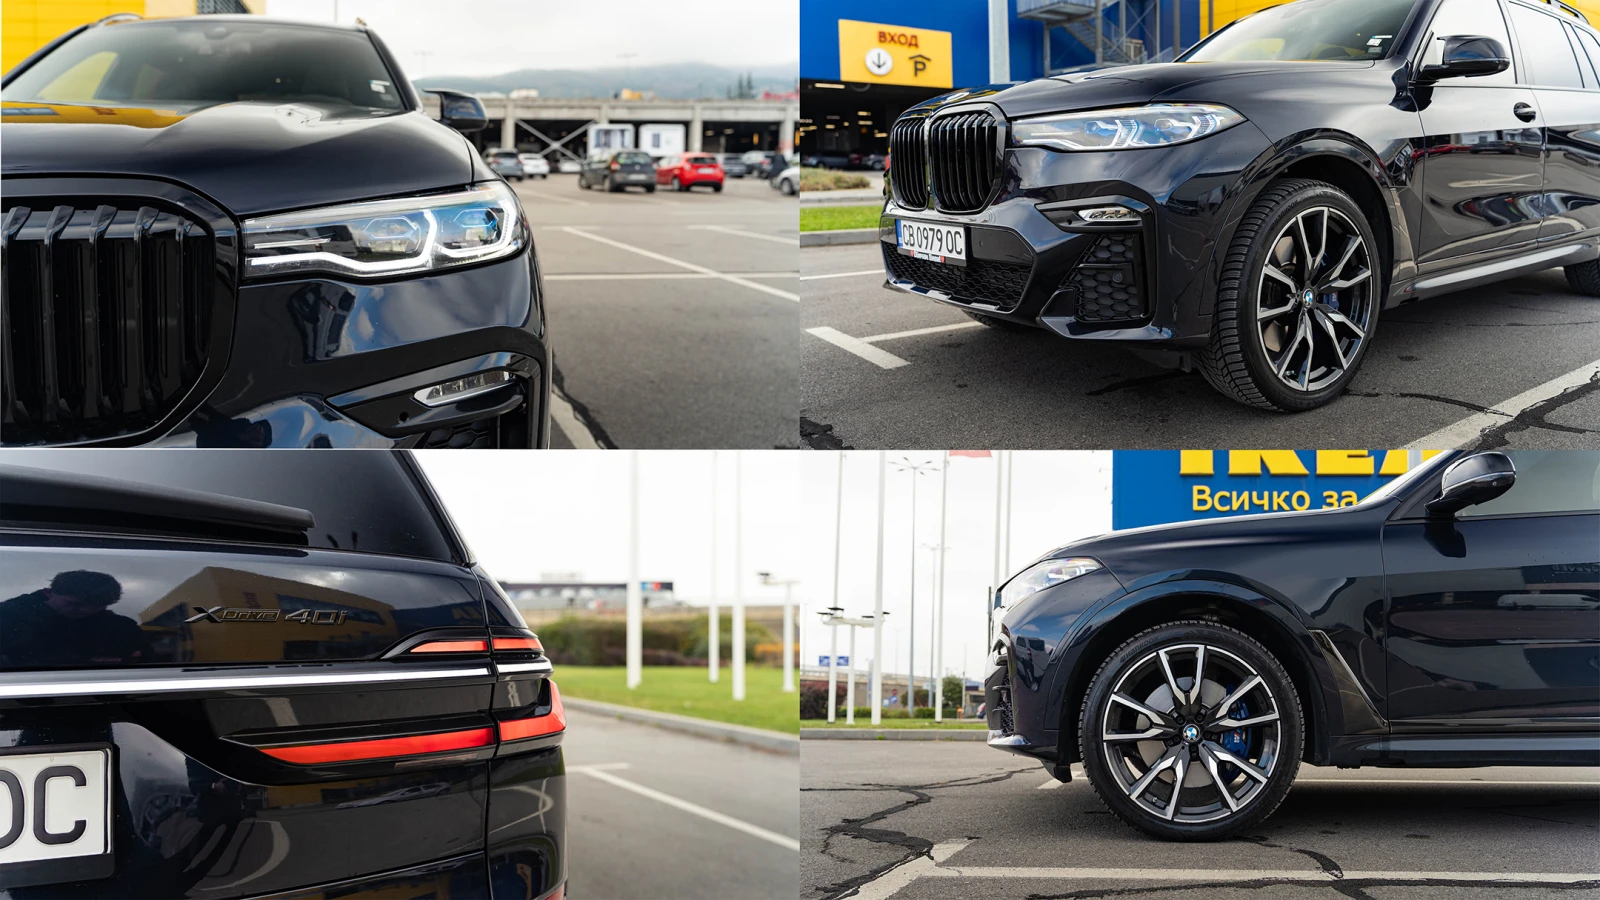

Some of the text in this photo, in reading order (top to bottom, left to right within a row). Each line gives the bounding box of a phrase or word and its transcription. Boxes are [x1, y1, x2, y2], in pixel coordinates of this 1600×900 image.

[878, 31, 919, 48] ВХОД
[902, 224, 915, 247] CB
[916, 226, 943, 252] 0979
[1192, 485, 1358, 512] Всичко за
[284, 608, 348, 625] 40i
